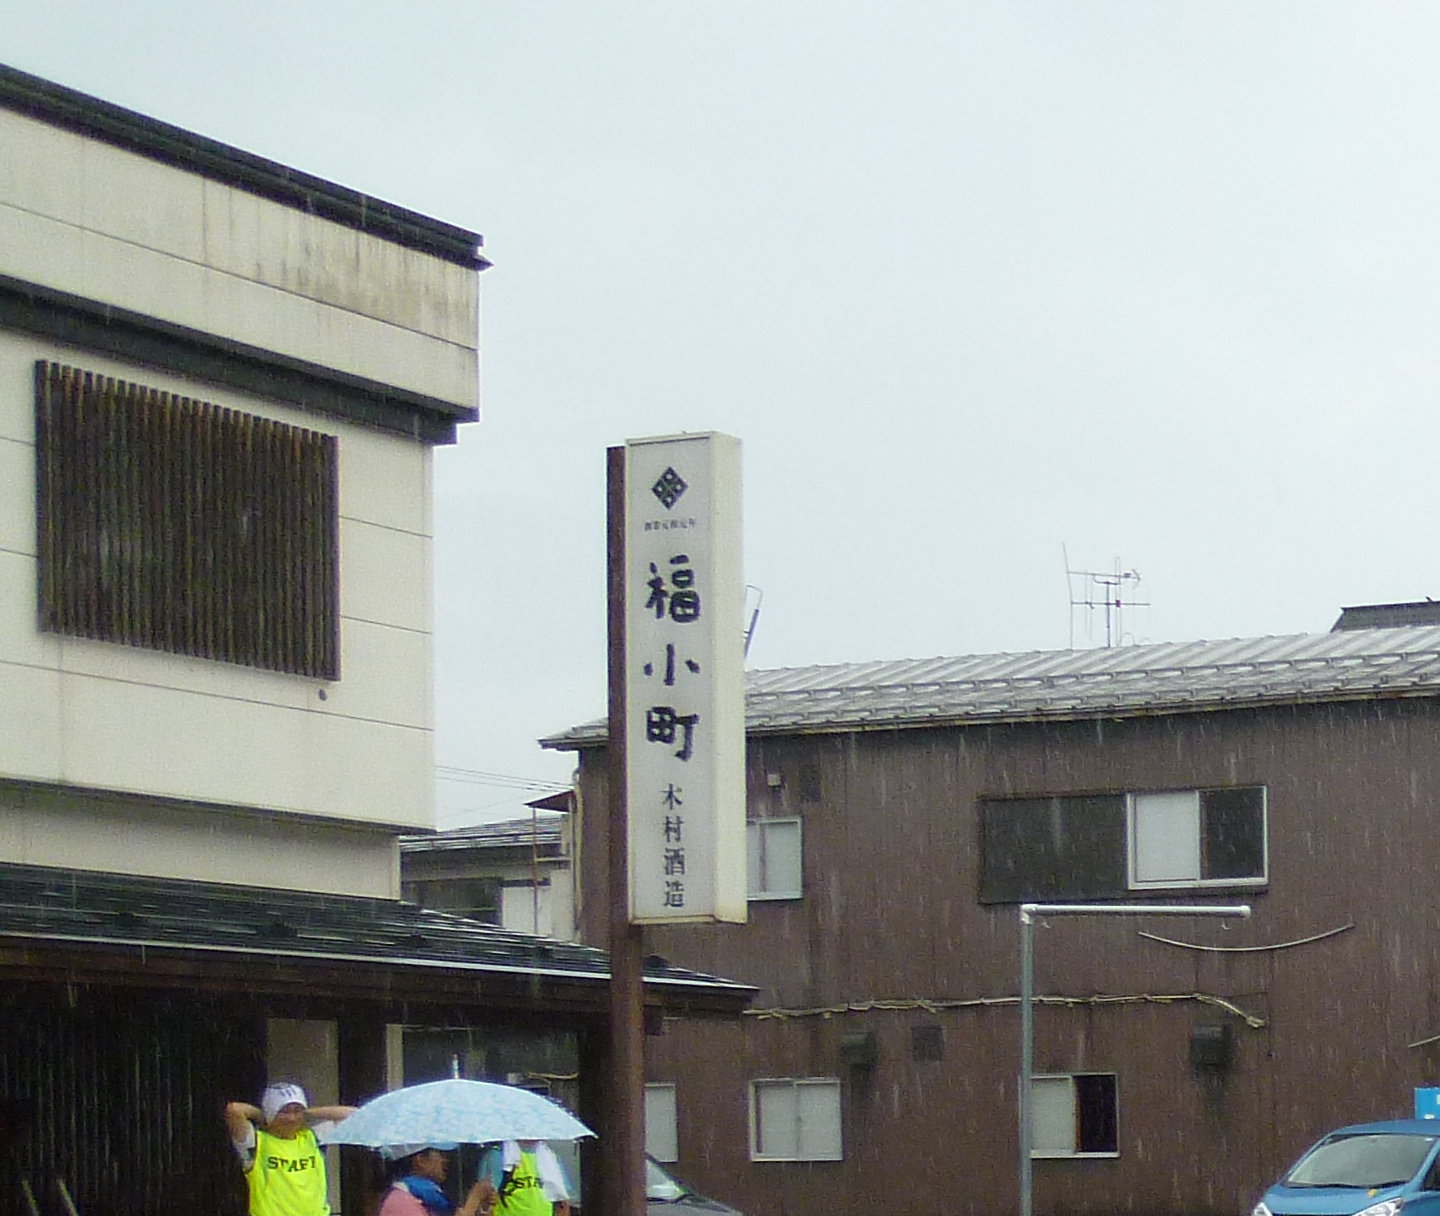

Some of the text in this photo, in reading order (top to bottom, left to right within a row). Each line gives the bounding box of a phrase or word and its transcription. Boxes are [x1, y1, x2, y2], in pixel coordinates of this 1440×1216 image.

[644, 554, 701, 761] 福小町
[661, 783, 686, 908] 木村酒造
